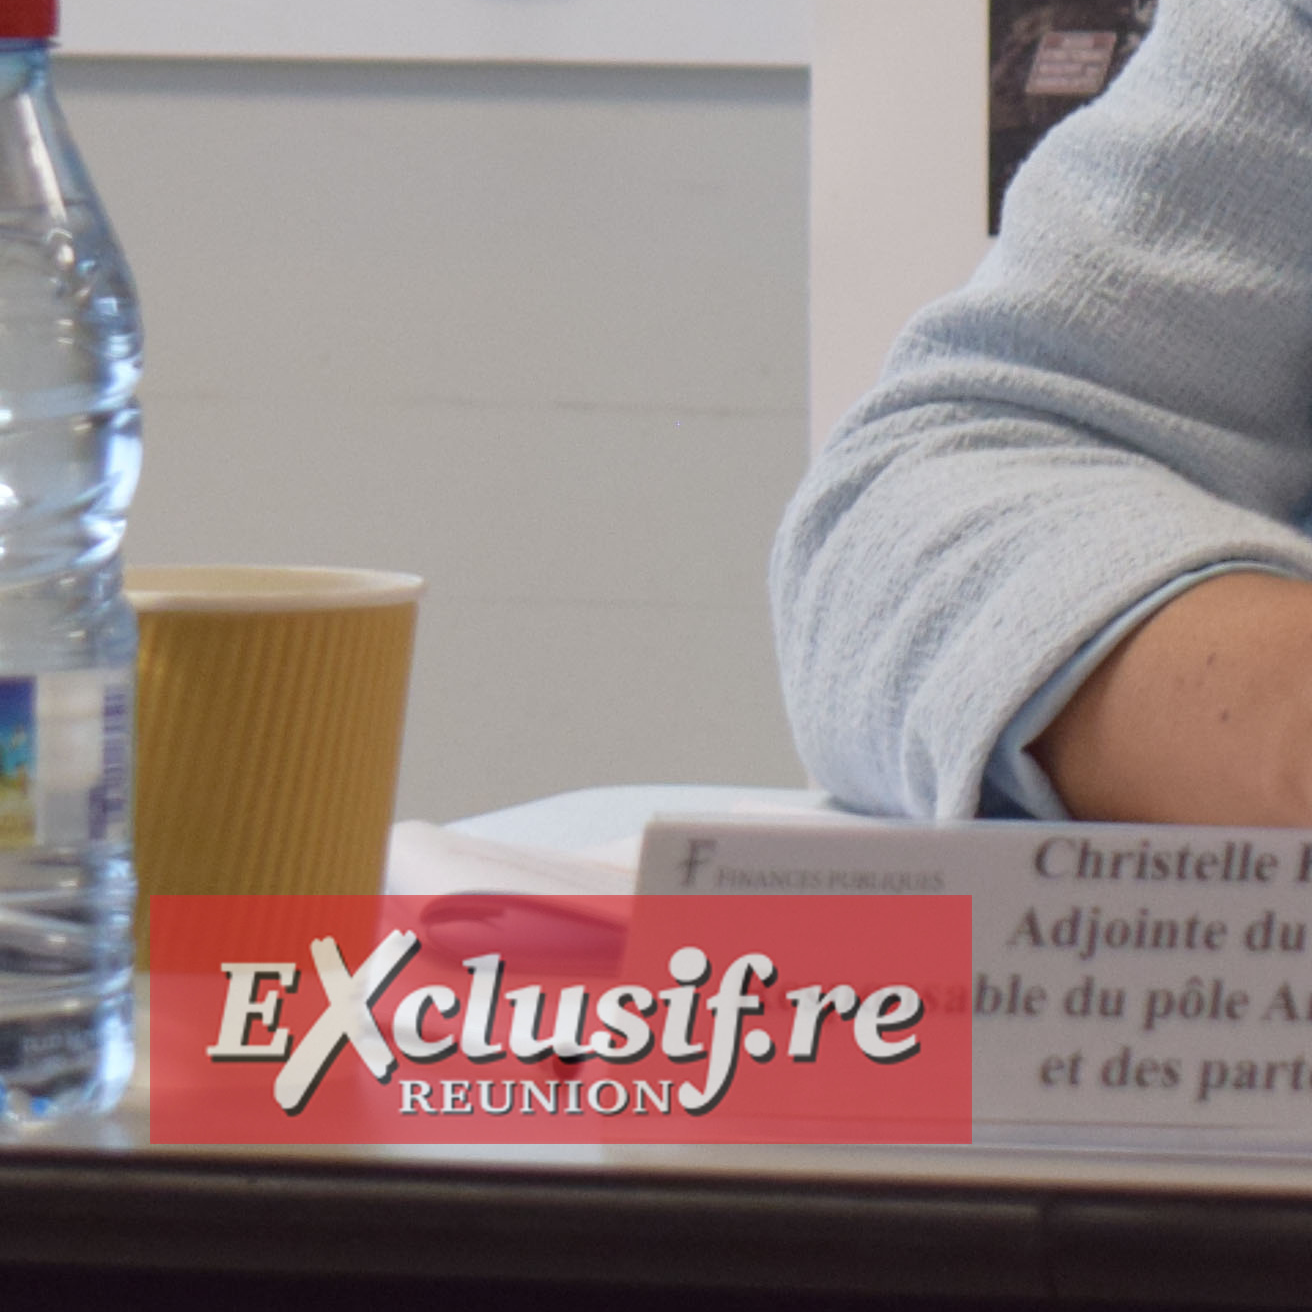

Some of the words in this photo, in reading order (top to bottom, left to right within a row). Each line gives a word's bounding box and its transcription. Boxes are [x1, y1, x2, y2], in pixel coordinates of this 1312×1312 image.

[1032, 836, 1279, 885] Christelle
[1008, 906, 1229, 962] Adjointe
[1243, 909, 1307, 954] du
[1063, 975, 1127, 1019] du
[1142, 975, 1250, 1032] pôle
[1038, 1051, 1084, 1089] et
[1100, 1045, 1181, 1090] des
